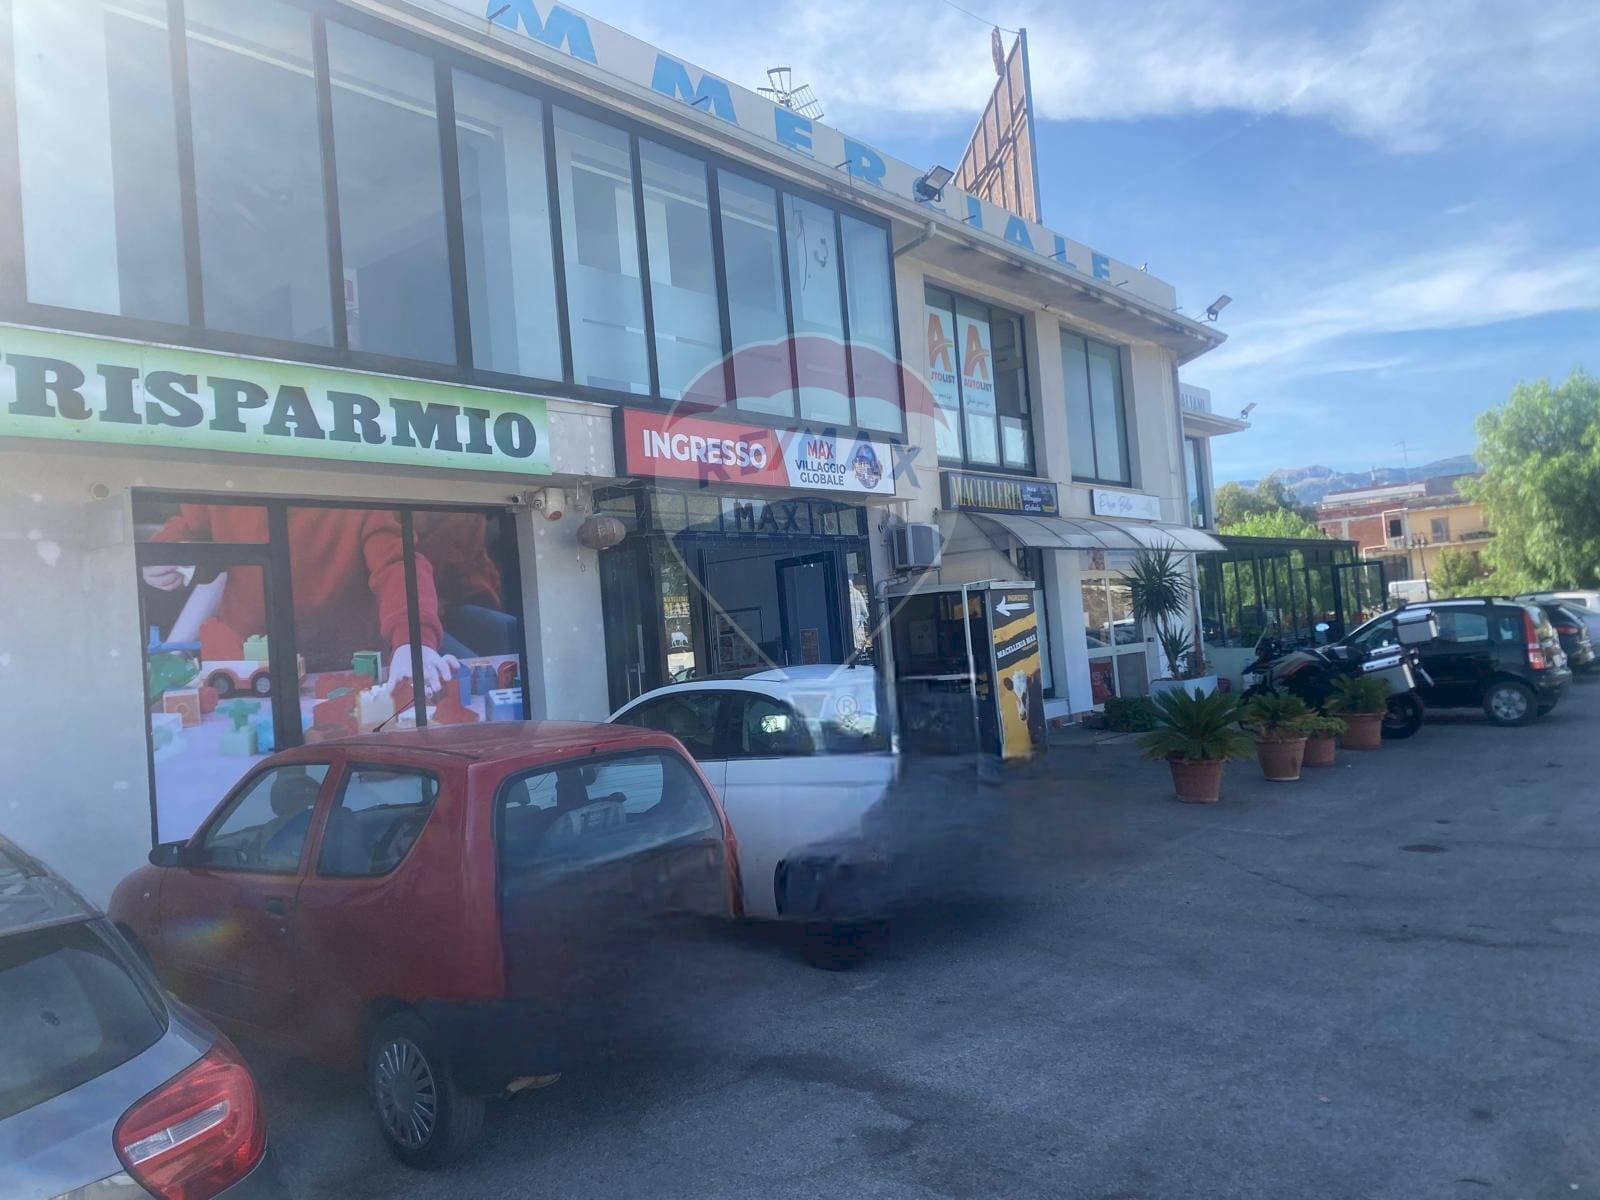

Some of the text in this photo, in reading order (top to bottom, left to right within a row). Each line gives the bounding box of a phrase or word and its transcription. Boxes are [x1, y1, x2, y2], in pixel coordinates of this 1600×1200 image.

[963, 378, 993, 392] AUTOLIST
[0, 352, 537, 459] RISPARMIO
[643, 429, 767, 470] INGRESSO
[807, 439, 834, 460] MAX
[795, 459, 847, 474] VILLAGGIO
[800, 471, 845, 486] GLOBALE
[950, 476, 1024, 511] MACELLERIA
[733, 502, 801, 533] MAX
